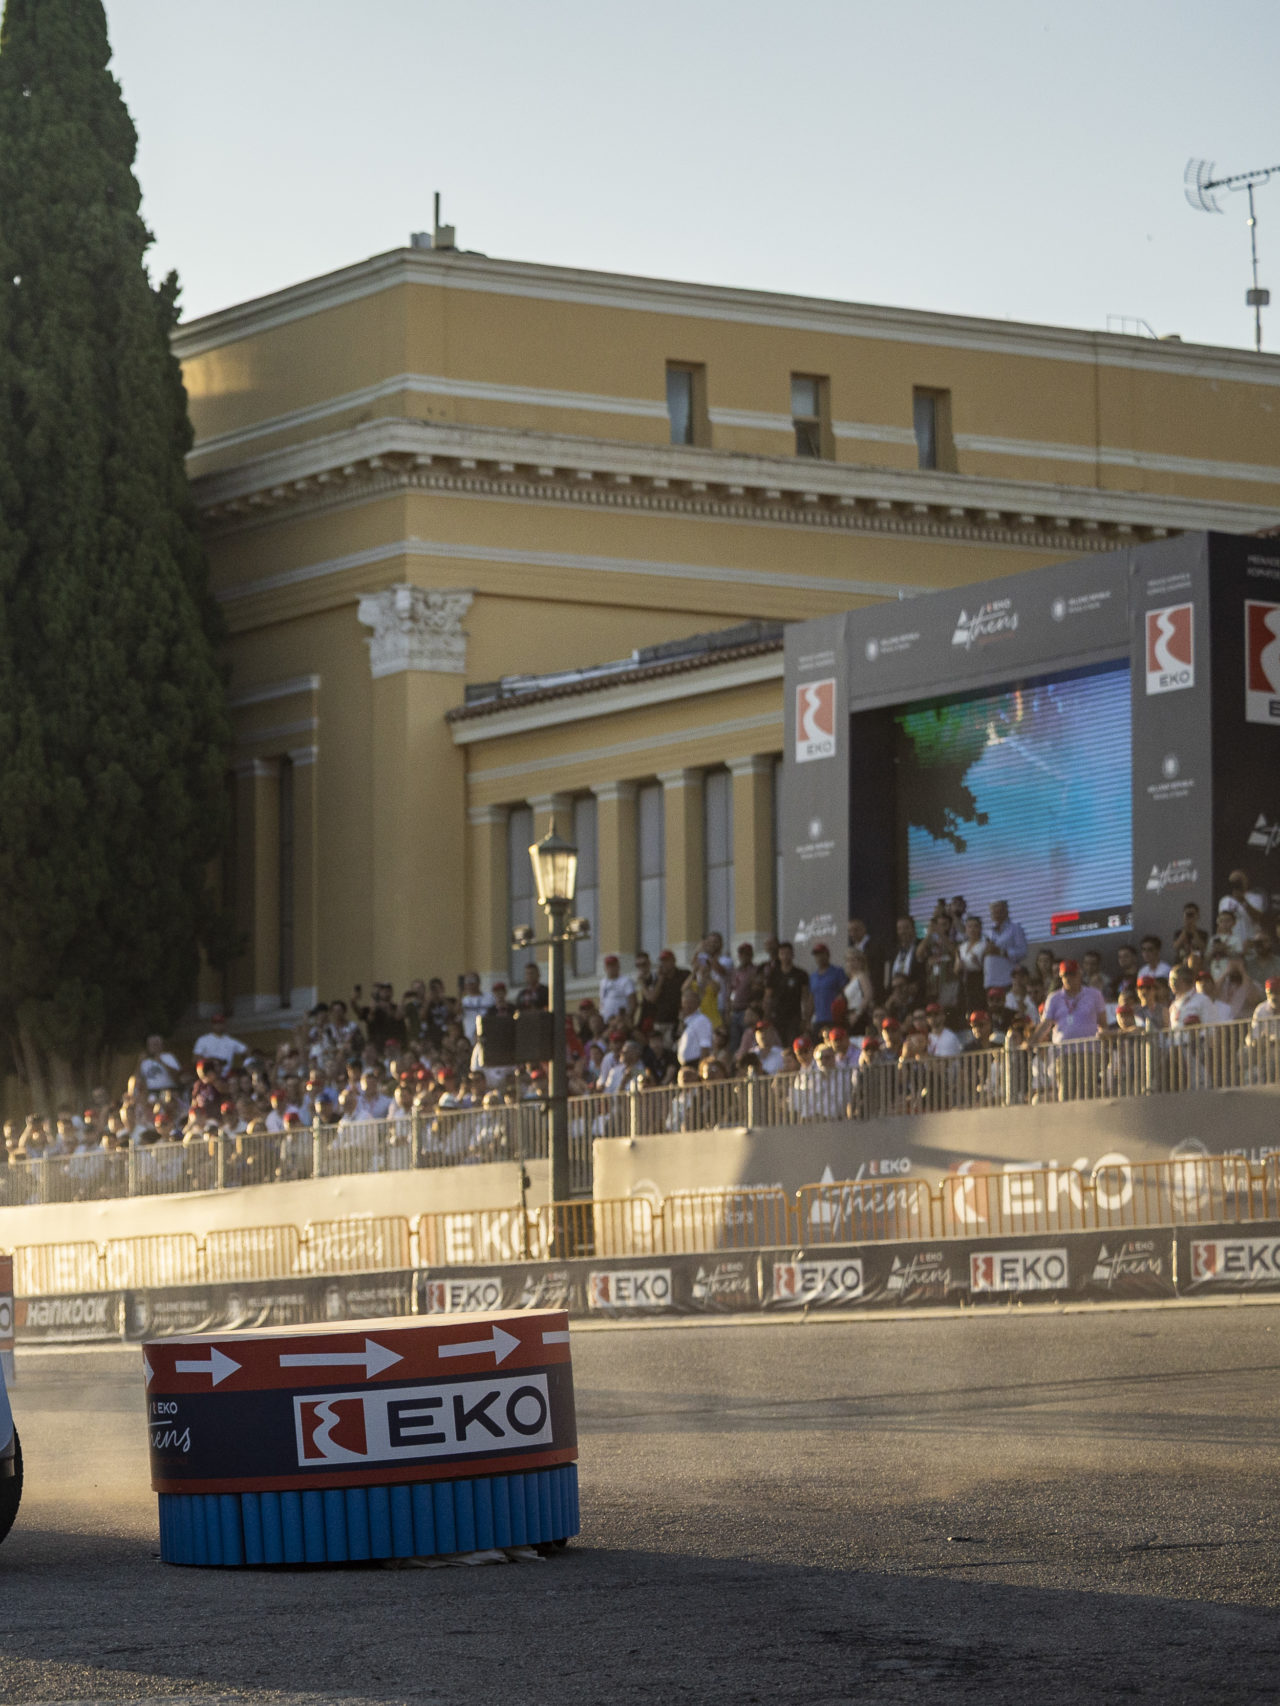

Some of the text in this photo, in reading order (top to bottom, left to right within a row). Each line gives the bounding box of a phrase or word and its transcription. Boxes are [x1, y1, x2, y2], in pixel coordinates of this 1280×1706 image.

[1159, 670, 1190, 688] EKO
[806, 742, 832, 756] EKO
[879, 1157, 912, 1175] EKO
[1003, 1152, 1133, 1215] EKO
[801, 1266, 860, 1292] EKO
[1000, 1256, 1065, 1283] EKO
[450, 1283, 500, 1309] EKO
[615, 1275, 670, 1300] EKO
[157, 1402, 178, 1414] EKO
[387, 1385, 548, 1448] EKO
